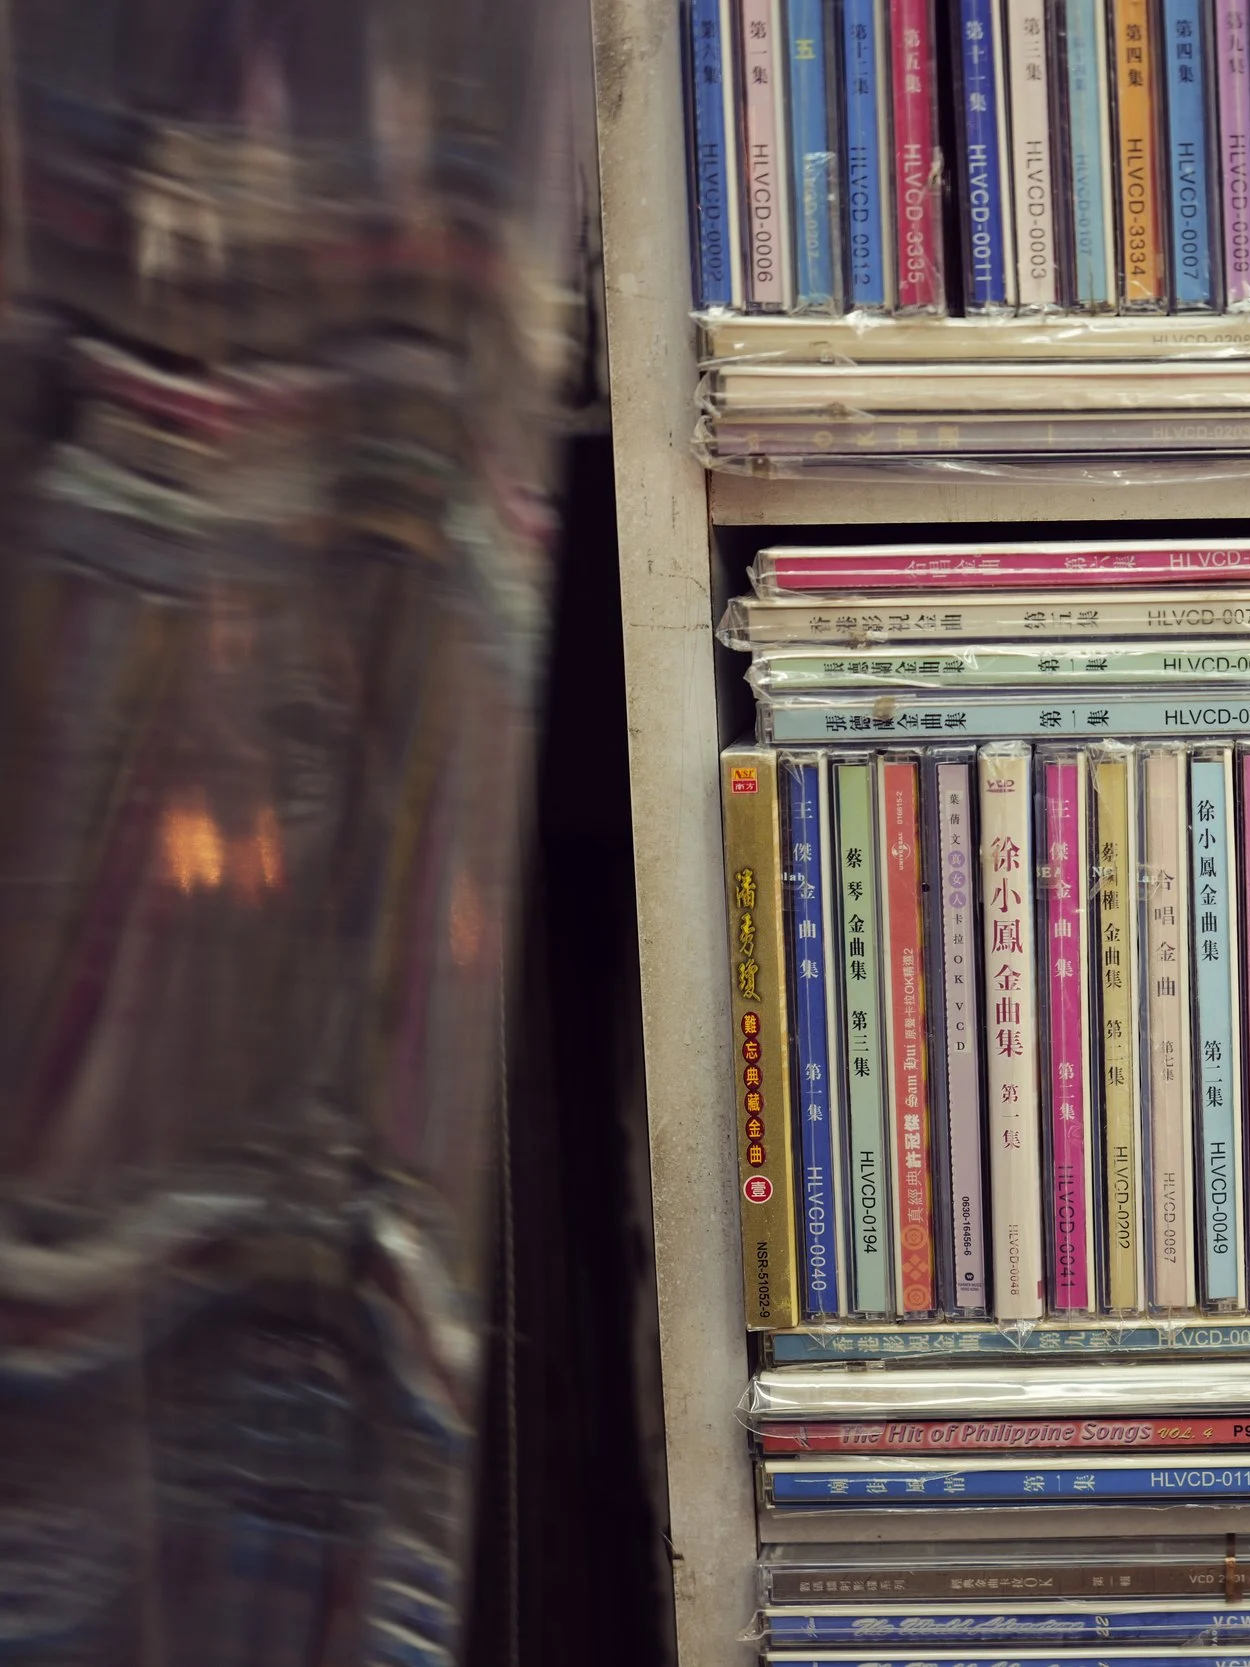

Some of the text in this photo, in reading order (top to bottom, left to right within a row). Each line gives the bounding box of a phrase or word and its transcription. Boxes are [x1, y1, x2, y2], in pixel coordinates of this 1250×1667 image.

[903, 28, 922, 94] 第五集
[703, 144, 723, 283] HLVCD-0002
[750, 20, 773, 283] 第一集 HLVCD-0006
[966, 21, 992, 282] 第十一集 HLVCD-0011
[1023, 17, 1047, 280] 第三集 HLVCD-0003
[1125, 23, 1147, 276] 第四集 HLVCD-3334
[1175, 19, 1198, 280] 第四集 HLVCD-0007
[904, 558, 1001, 580] 合唱金曲
[825, 711, 968, 733] 張德蘭金曲集
[1039, 709, 1110, 730] 第一集
[793, 800, 819, 979] 王傑金曲集
[990, 836, 1025, 1058] 徐小鳳金曲集
[1049, 799, 1074, 979] 王傑金曲集
[805, 1062, 824, 1122] 第一集
[846, 847, 878, 1254] 蔡琴金曲集 第三集 HLVCD-0194
[951, 853, 973, 1256] 真女人 0630-16456-6
[1058, 1062, 1076, 1122] 第二集
[1153, 868, 1177, 1264] 合唱金曲 HLVCD-0067
[1197, 799, 1229, 1255] 徐小鳳金曲集 第二集 HLVCD-0049
[1002, 1084, 1023, 1151] 第一集
[1106, 1019, 1130, 1250] 第二集 HLVCD-0202
[756, 1241, 771, 1319] NSR-51052-9
[807, 1166, 827, 1292] HLVCD-0040
[1057, 1165, 1076, 1289] HLVCD-0041
[887, 1422, 926, 1443] Hit
[930, 1421, 959, 1444] of
[961, 1421, 1075, 1446] Philippine
[1080, 1421, 1153, 1446] Songs
[1023, 1475, 1097, 1493] 第一集
[1188, 1574, 1216, 1585] VCD
